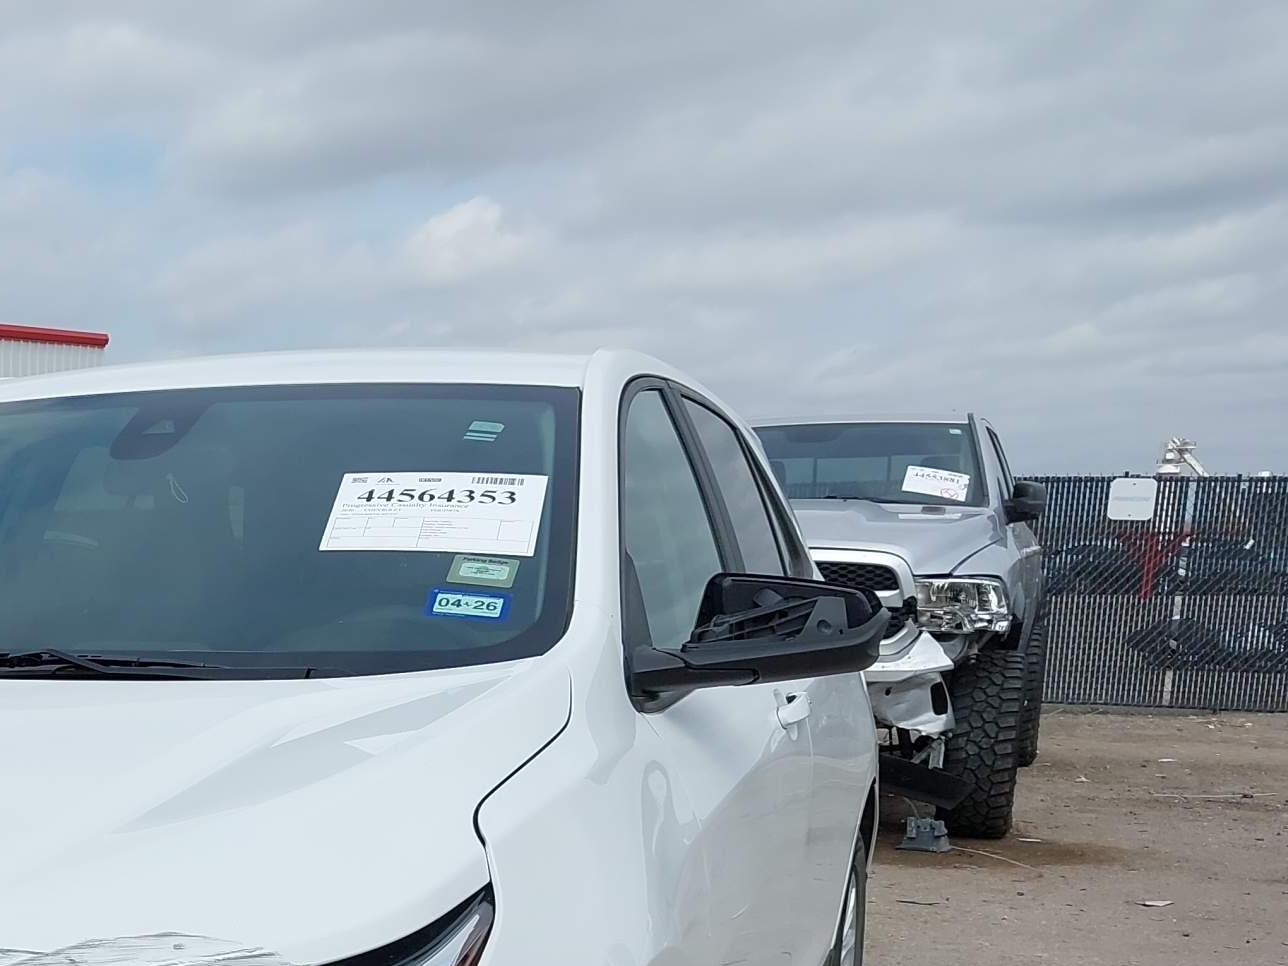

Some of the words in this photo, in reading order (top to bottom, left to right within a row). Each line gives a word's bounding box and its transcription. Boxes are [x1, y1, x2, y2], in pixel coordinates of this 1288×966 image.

[357, 488, 517, 504] 44564353
[438, 597, 463, 608] 04
[472, 600, 499, 611] 26
